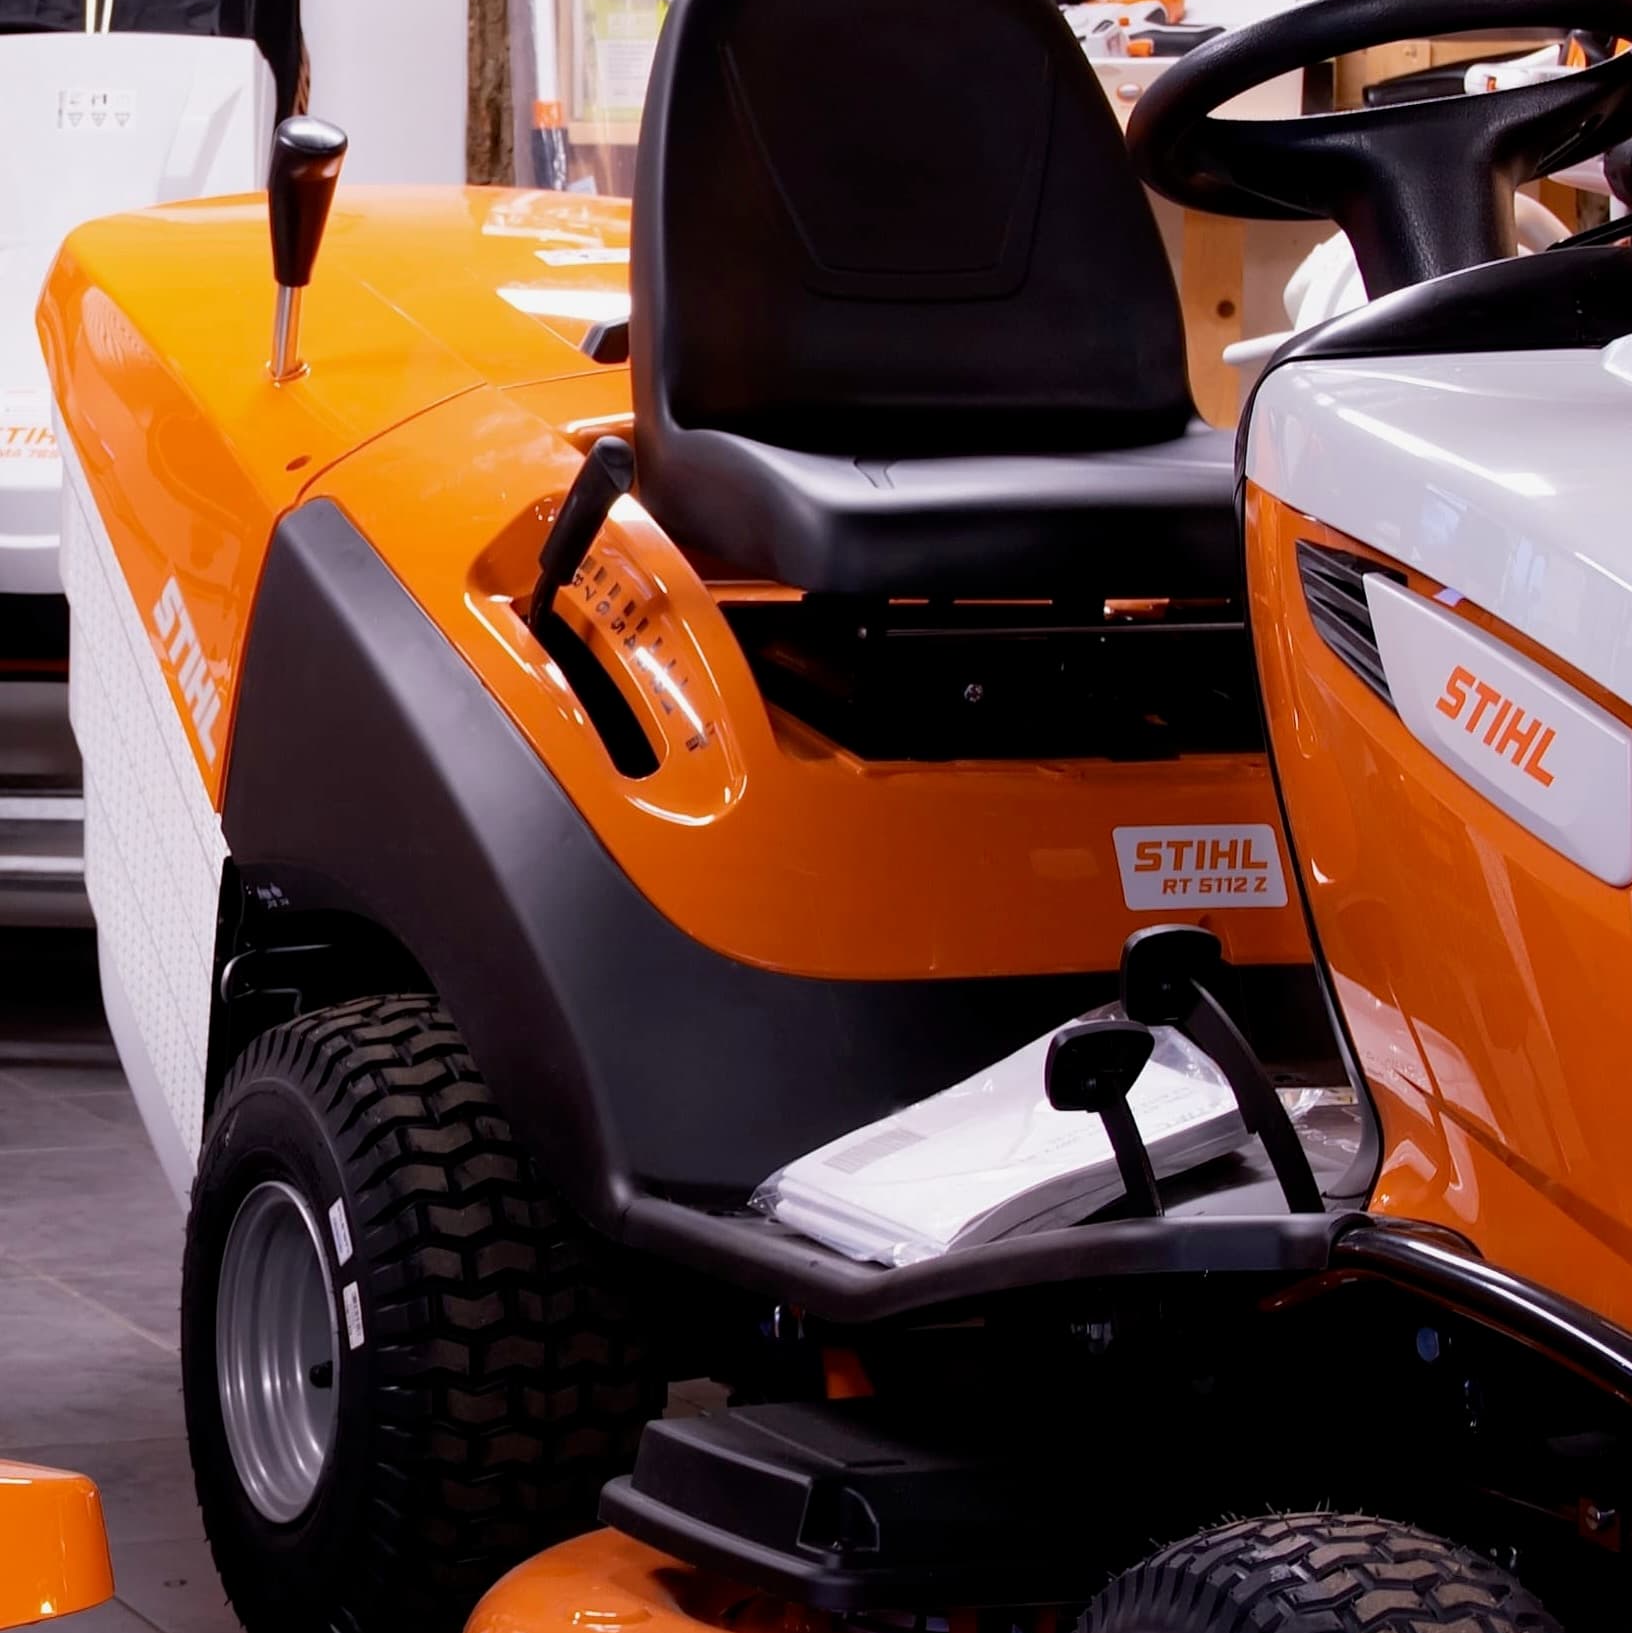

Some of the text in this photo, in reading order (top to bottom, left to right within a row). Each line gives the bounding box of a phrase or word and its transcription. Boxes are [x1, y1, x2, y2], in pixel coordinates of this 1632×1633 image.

[610, 617, 626, 635] 5
[151, 575, 229, 766] STIHL
[1435, 664, 1557, 788] STIHL
[1134, 839, 1268, 872] STIHL
[1162, 876, 1267, 895] RT 5112 Z
